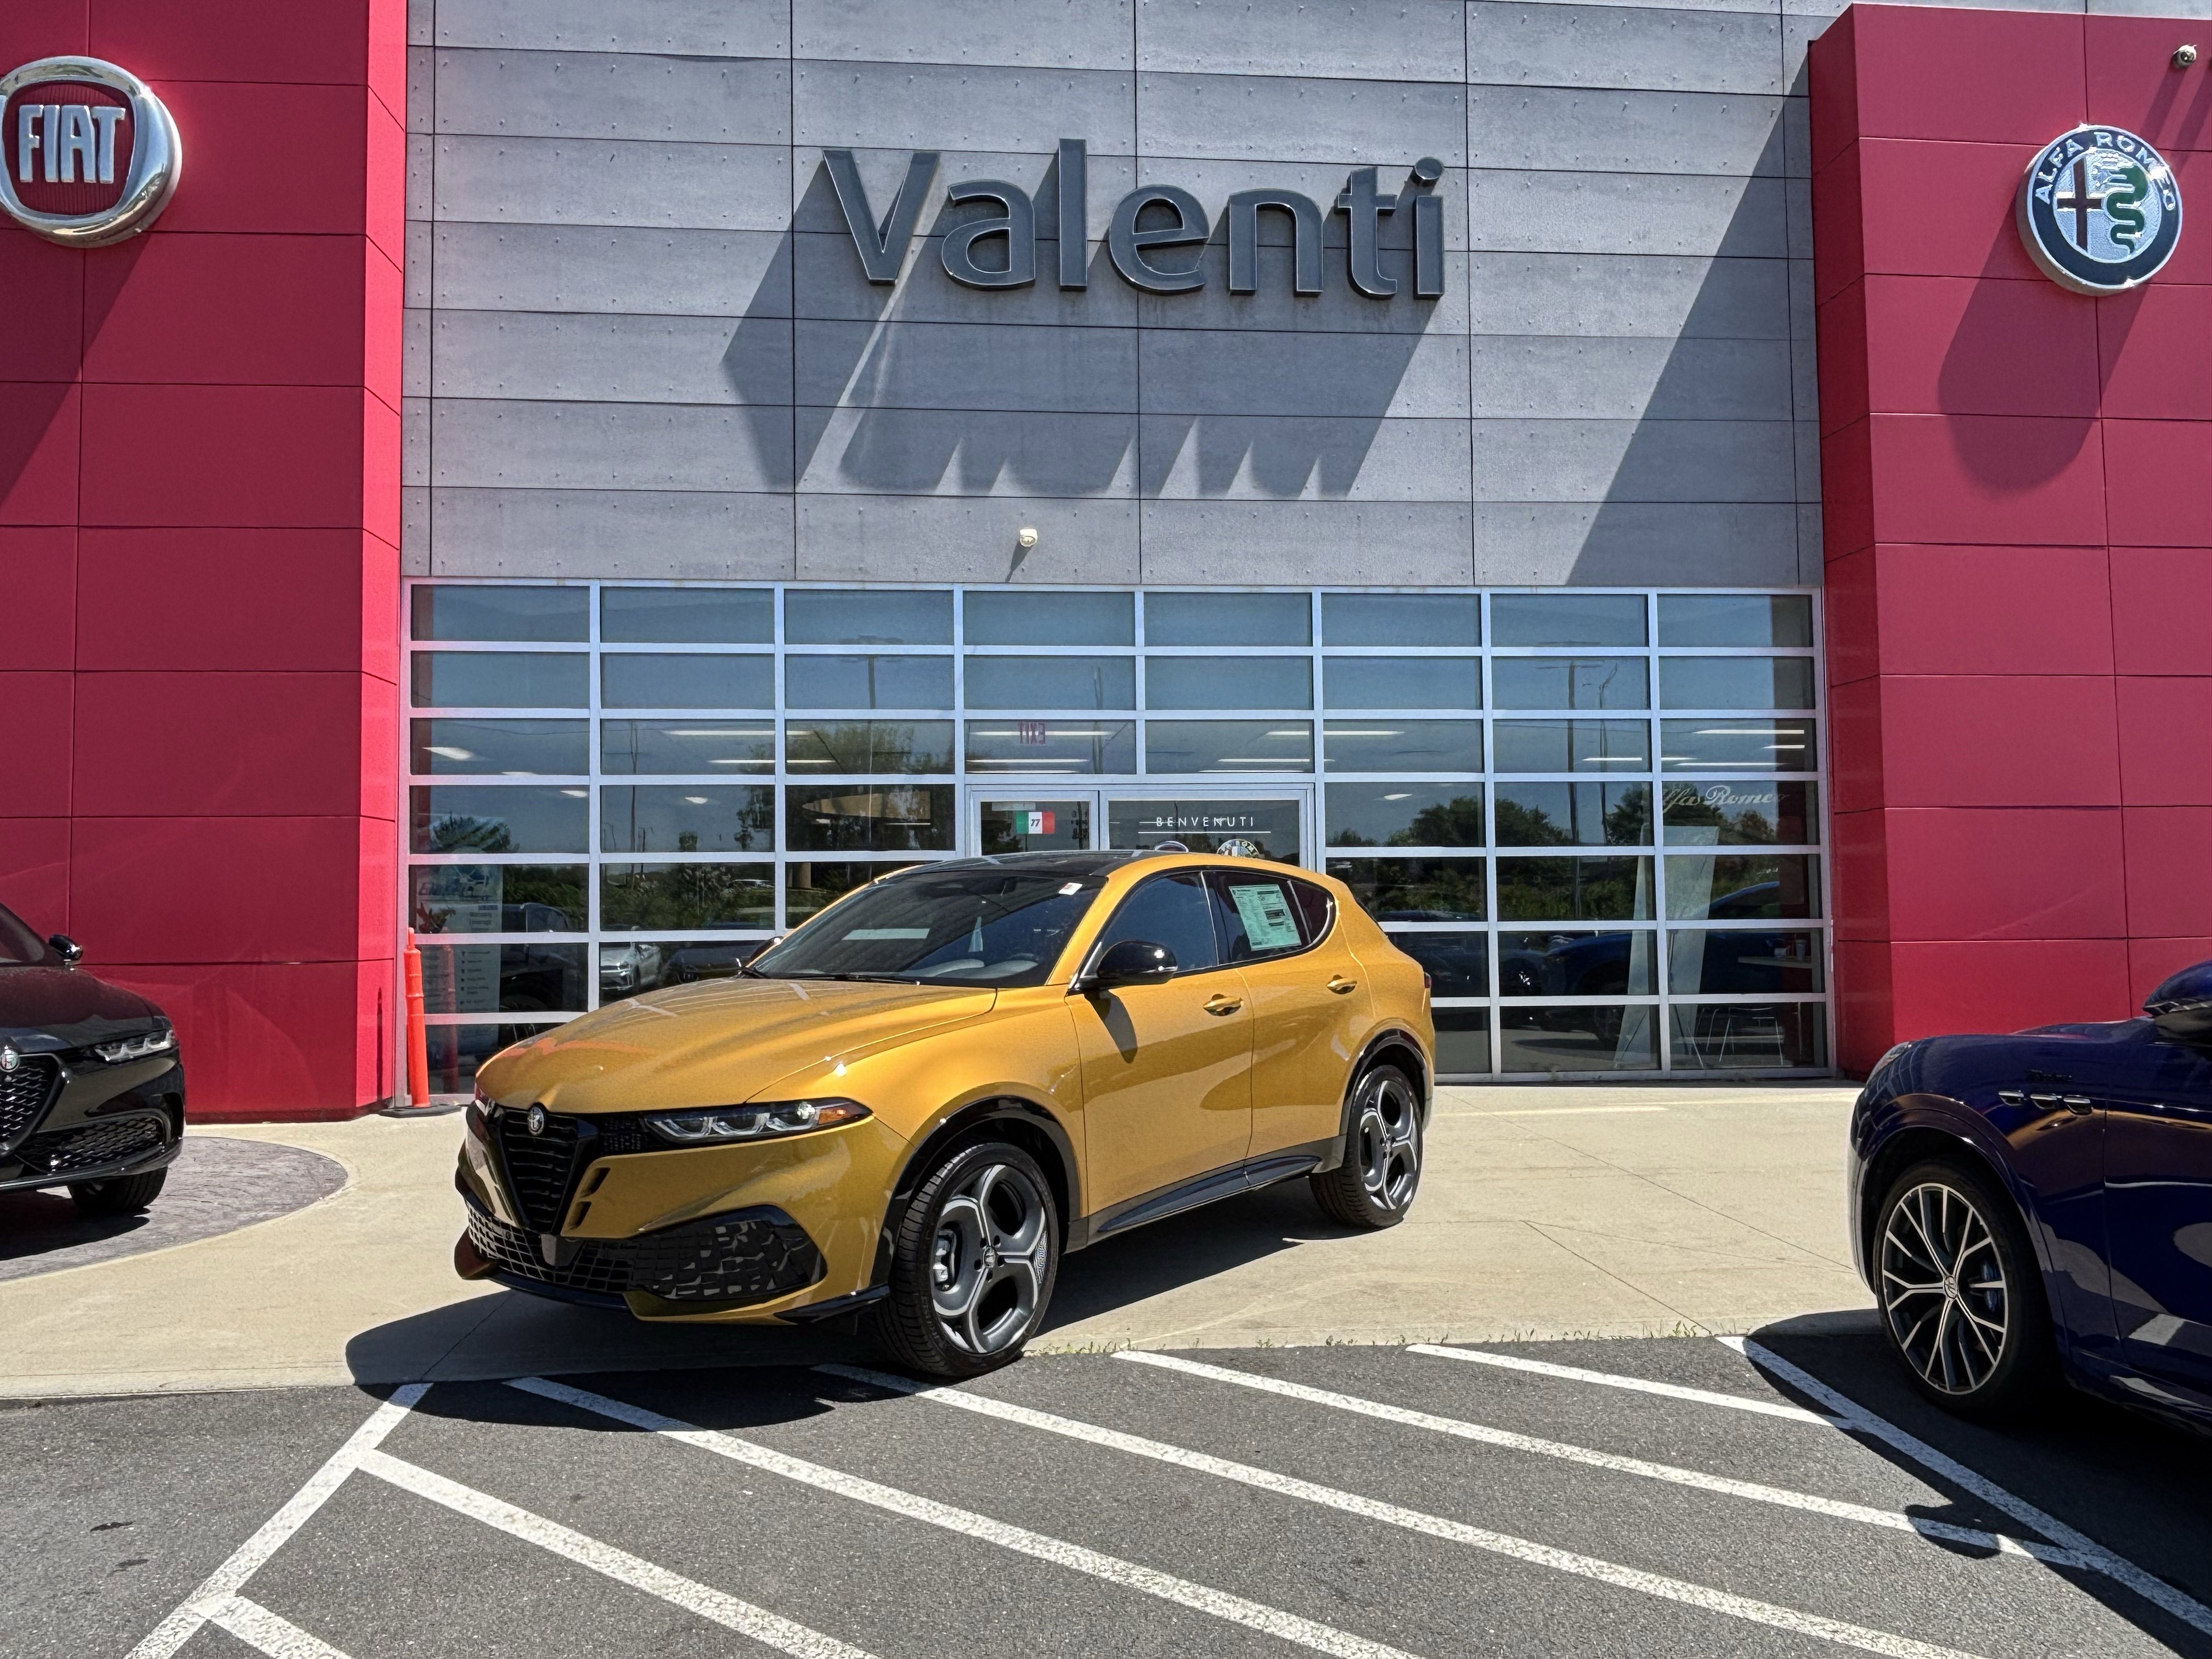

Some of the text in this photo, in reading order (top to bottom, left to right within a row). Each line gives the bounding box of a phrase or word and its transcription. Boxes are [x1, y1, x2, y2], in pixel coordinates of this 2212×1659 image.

[19, 104, 126, 183] FIAT
[2036, 138, 2084, 205] ALFA
[822, 138, 1445, 300] Valenti
[1156, 816, 1254, 827] BENVENUTI
